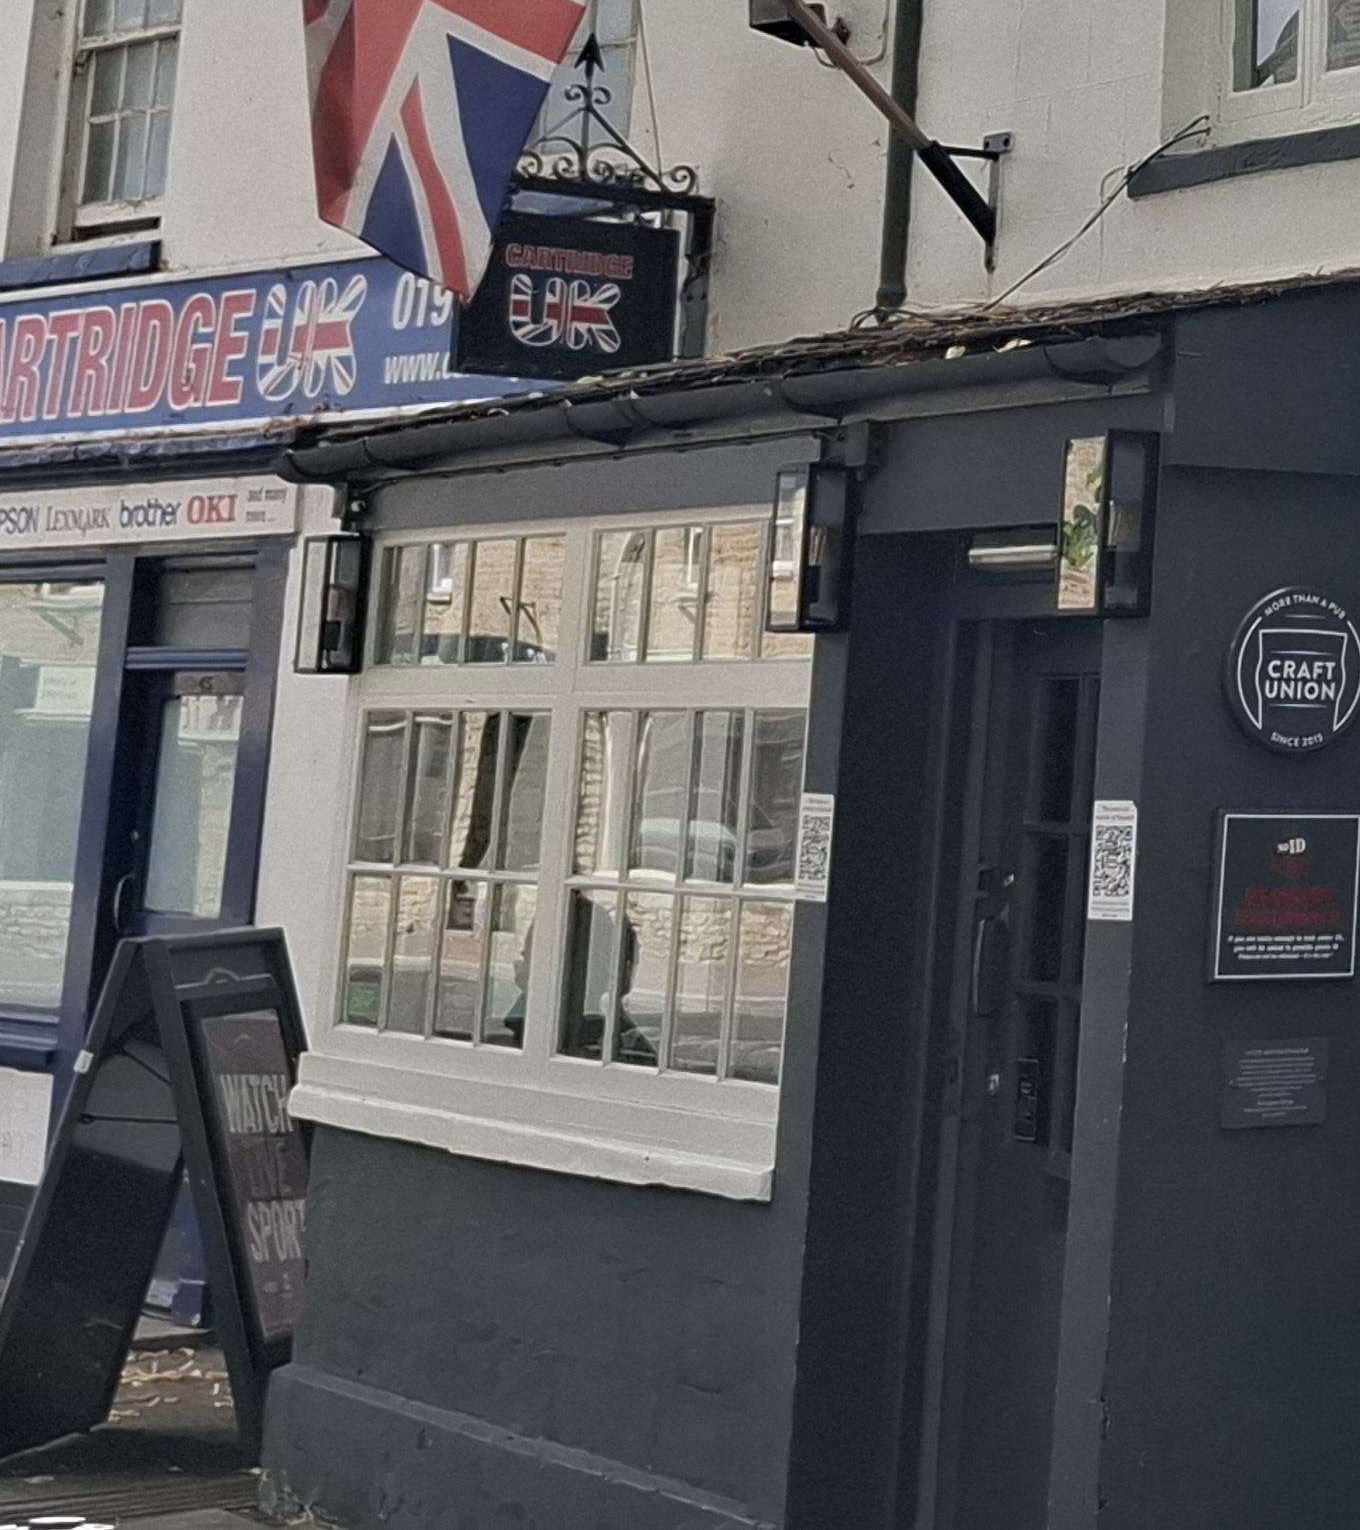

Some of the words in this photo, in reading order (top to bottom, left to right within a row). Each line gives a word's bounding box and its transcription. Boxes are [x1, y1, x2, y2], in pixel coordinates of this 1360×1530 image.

[504, 242, 635, 280] CARTRIDGE
[508, 273, 622, 354] UK
[256, 272, 368, 402] UK
[118, 496, 182, 530] brother
[186, 493, 239, 525] OKI
[1263, 595, 1291, 617] MORE
[1292, 594, 1320, 605] THAN
[1319, 598, 1328, 609] A
[1327, 601, 1347, 620] PUB
[1266, 659, 1337, 681] CRAFT
[1264, 679, 1337, 701] UNION
[219, 1073, 295, 1134] WATCH
